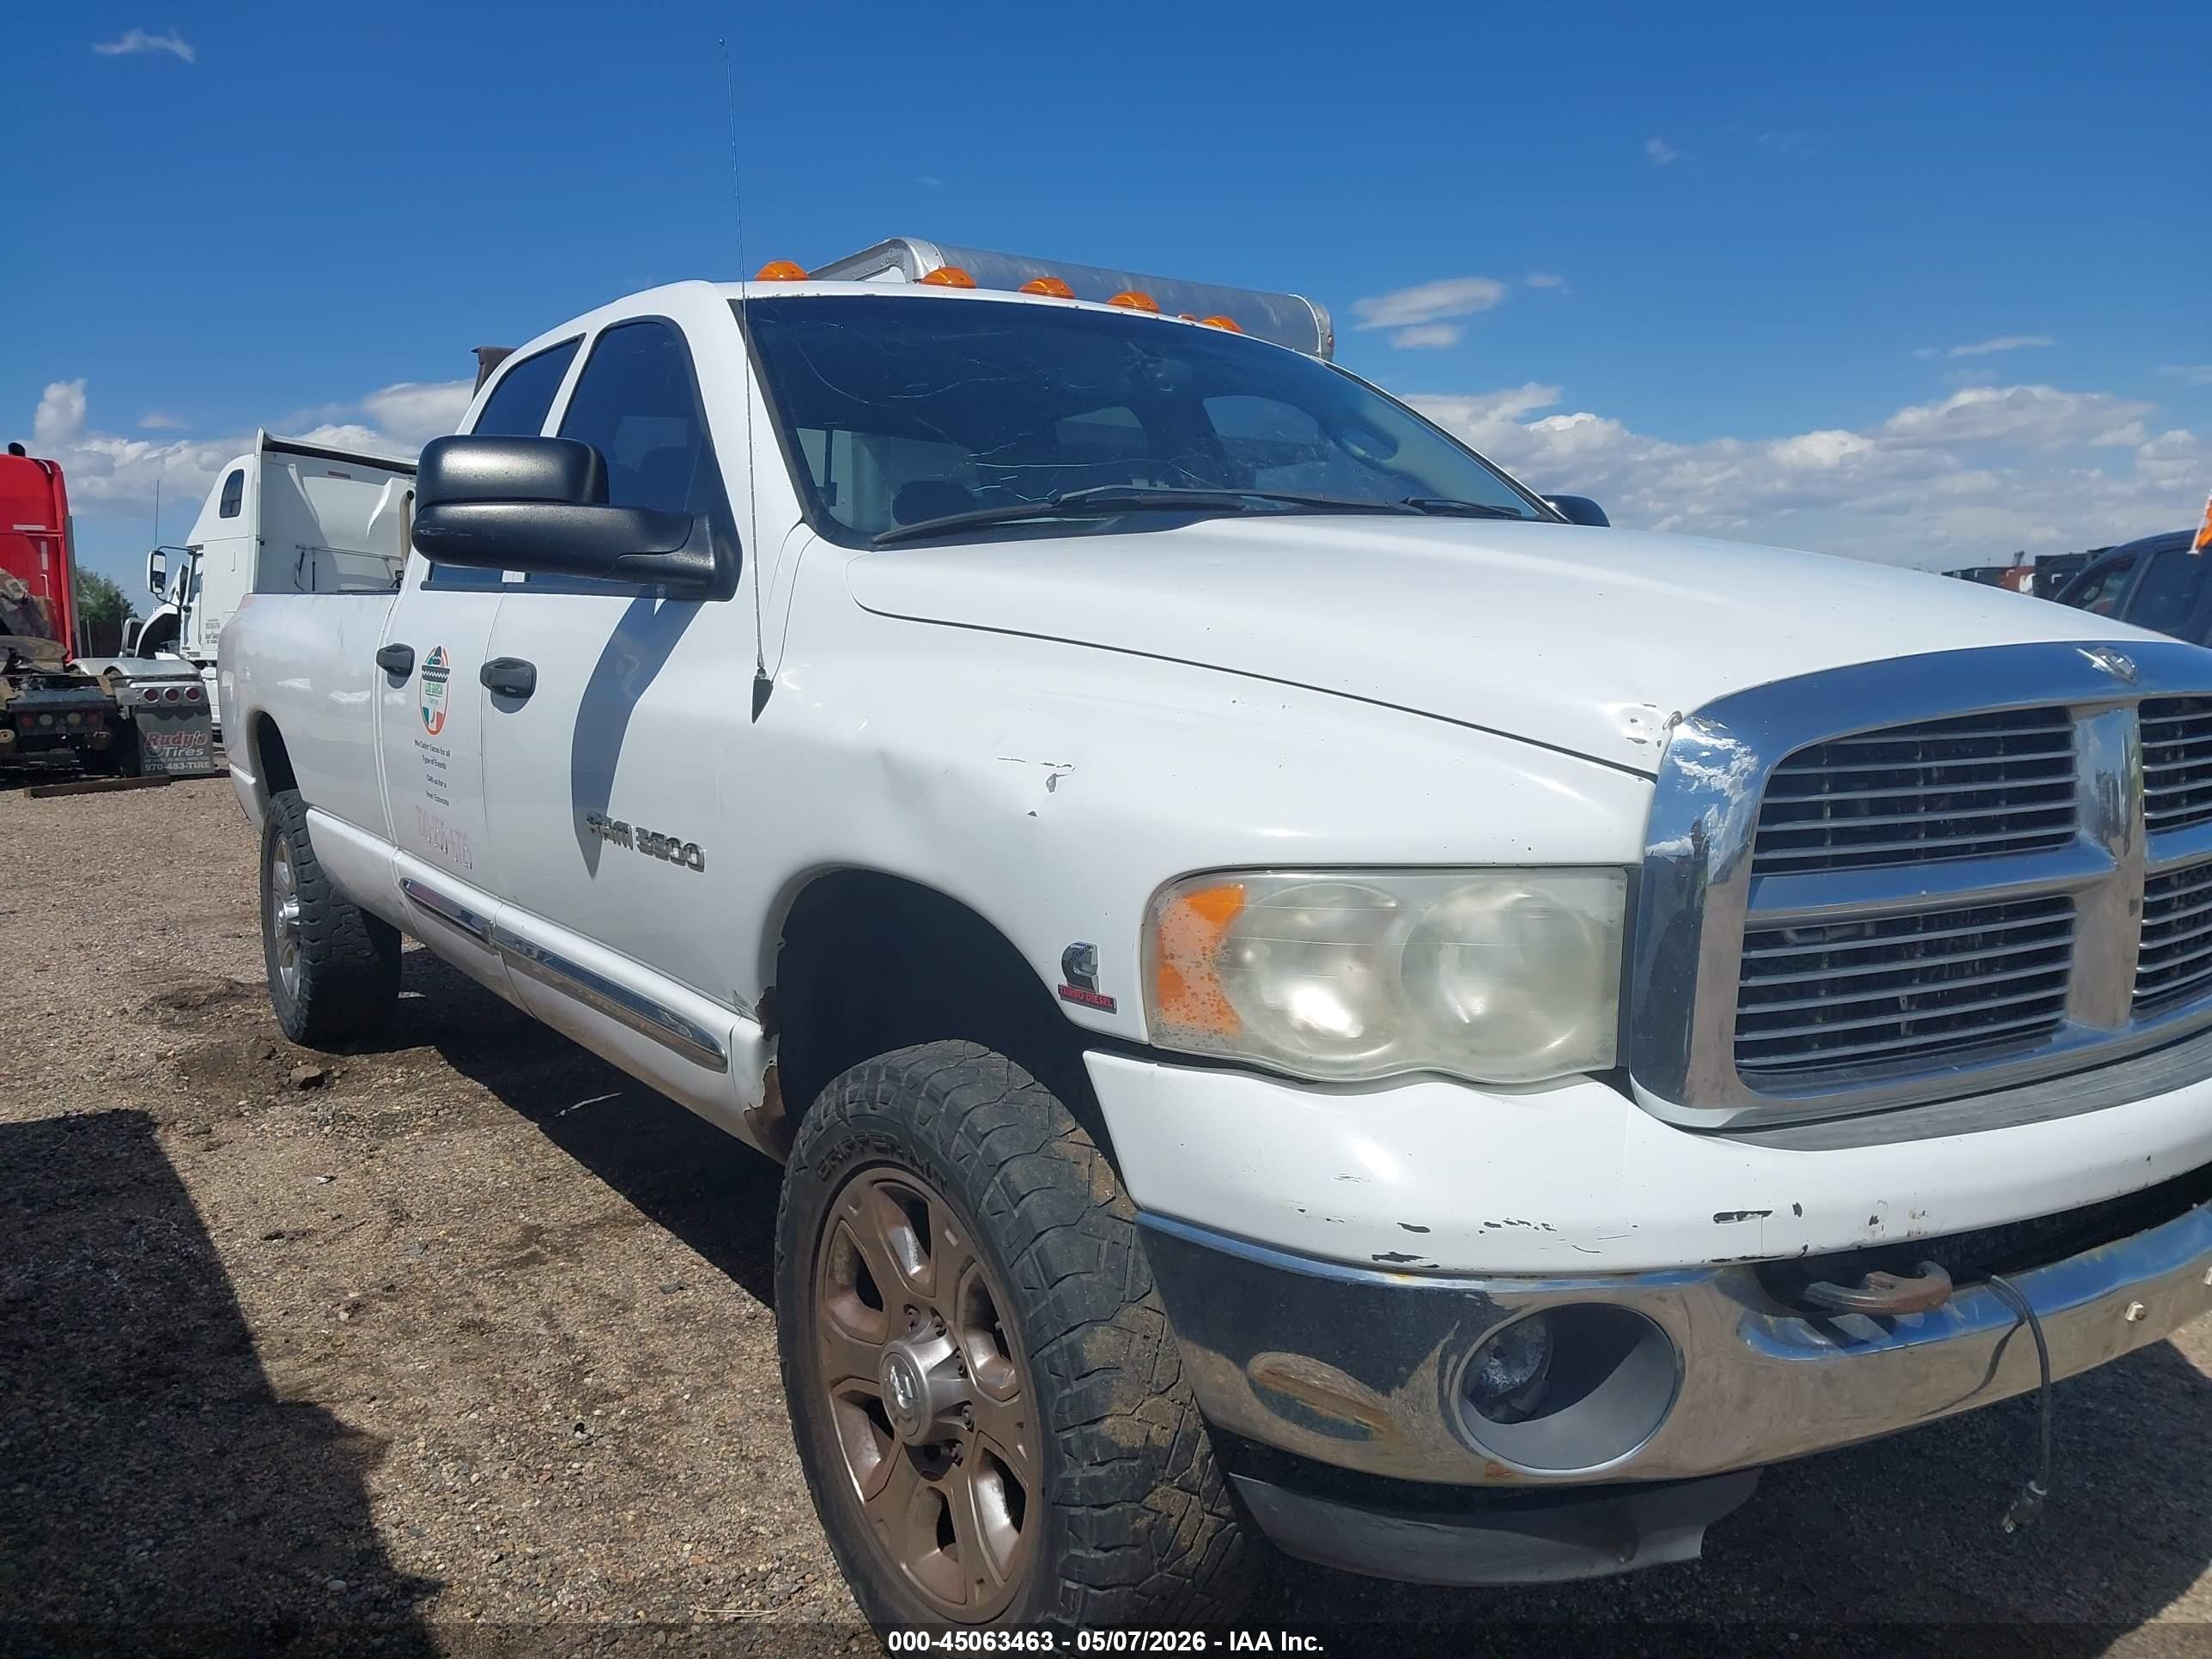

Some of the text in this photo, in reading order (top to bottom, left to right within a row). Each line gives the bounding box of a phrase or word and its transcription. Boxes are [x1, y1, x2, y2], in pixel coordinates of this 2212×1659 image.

[145, 730, 208, 749] Rudy's
[162, 746, 205, 757] Tires
[144, 761, 211, 771] 970-483-TIRE
[635, 826, 705, 873] 3500
[1059, 986, 1114, 1007] TURBO DIESEL
